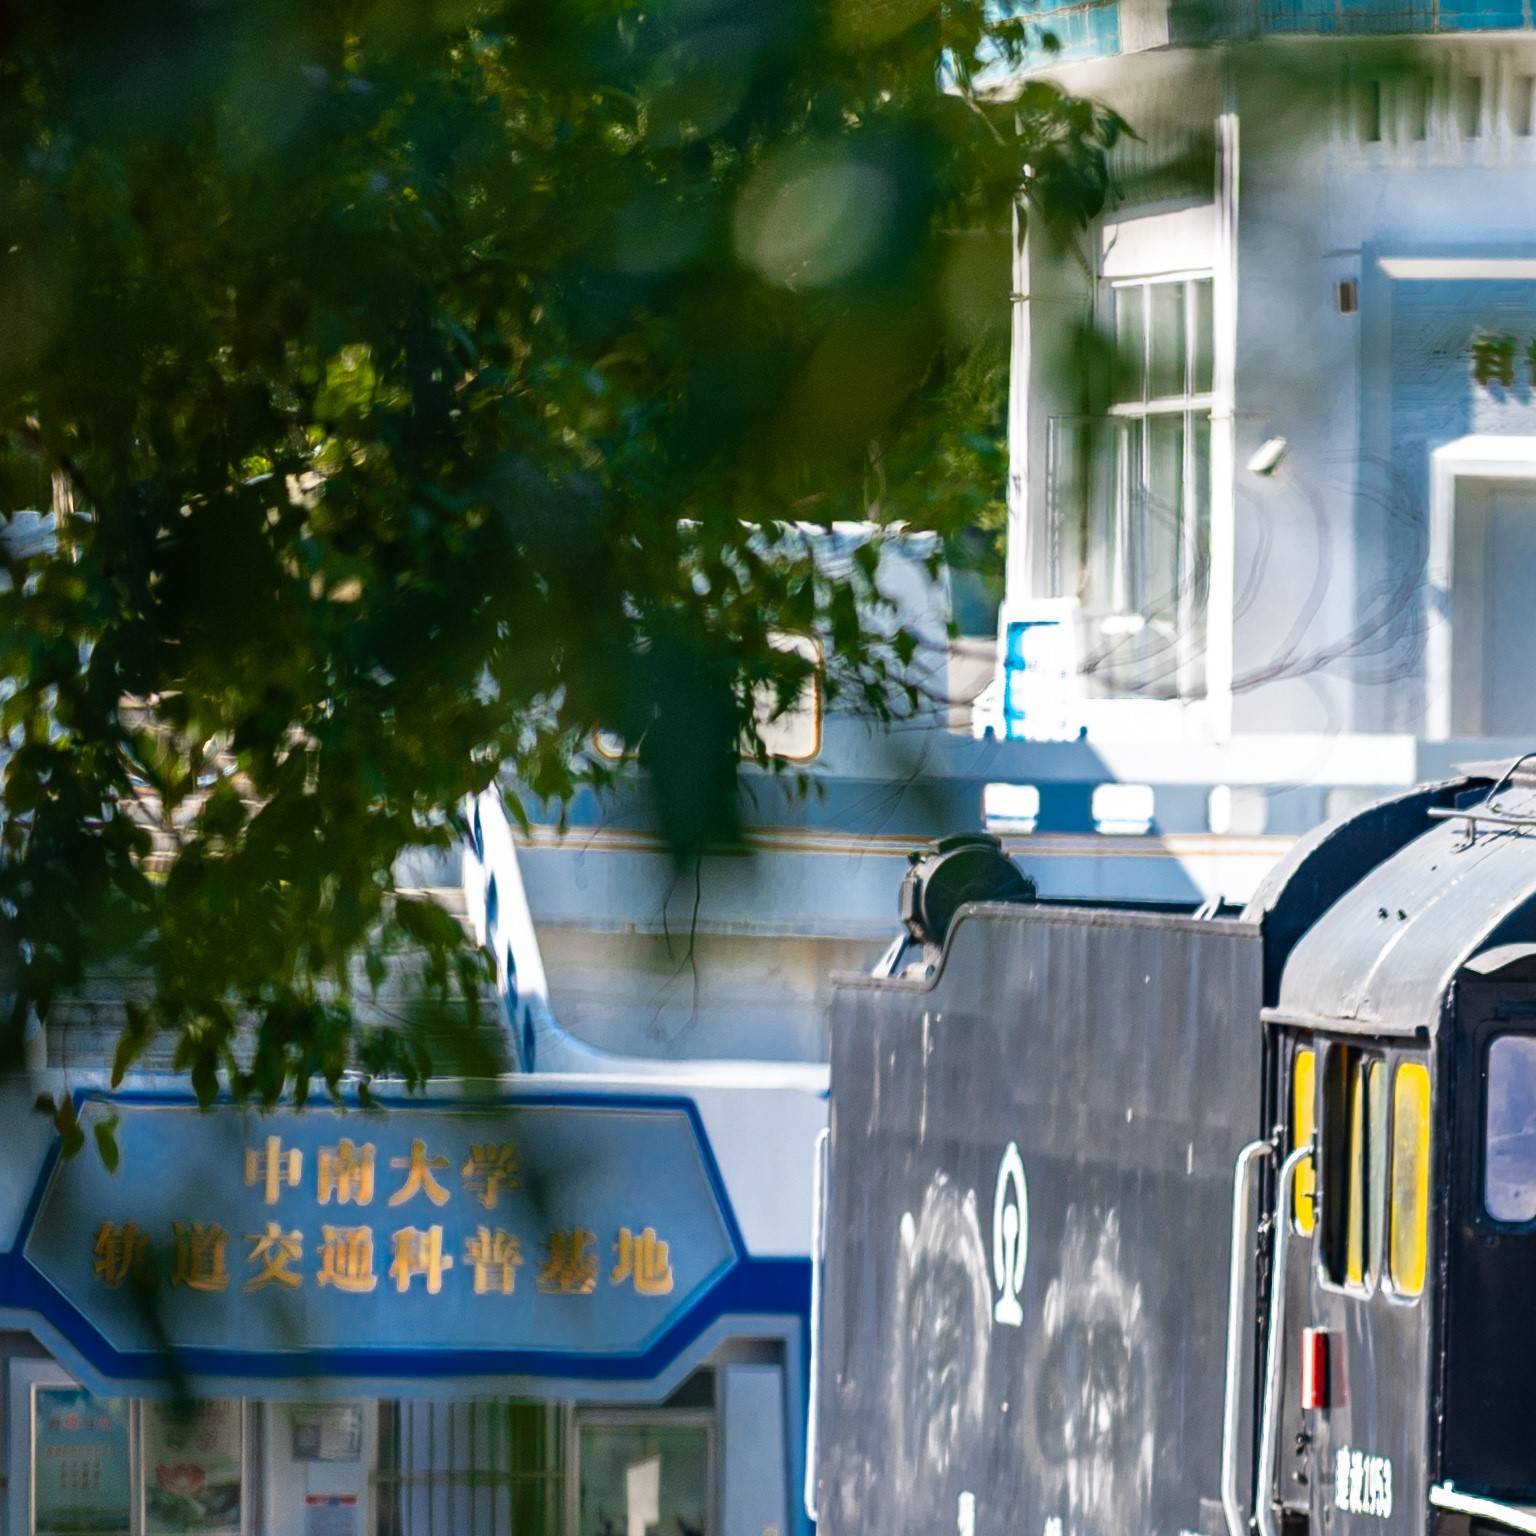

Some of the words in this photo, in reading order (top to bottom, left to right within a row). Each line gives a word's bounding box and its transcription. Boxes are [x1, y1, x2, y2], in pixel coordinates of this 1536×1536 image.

[244, 1136, 522, 1209] 中南大学
[94, 1222, 675, 1296] 轨道交通科普基地
